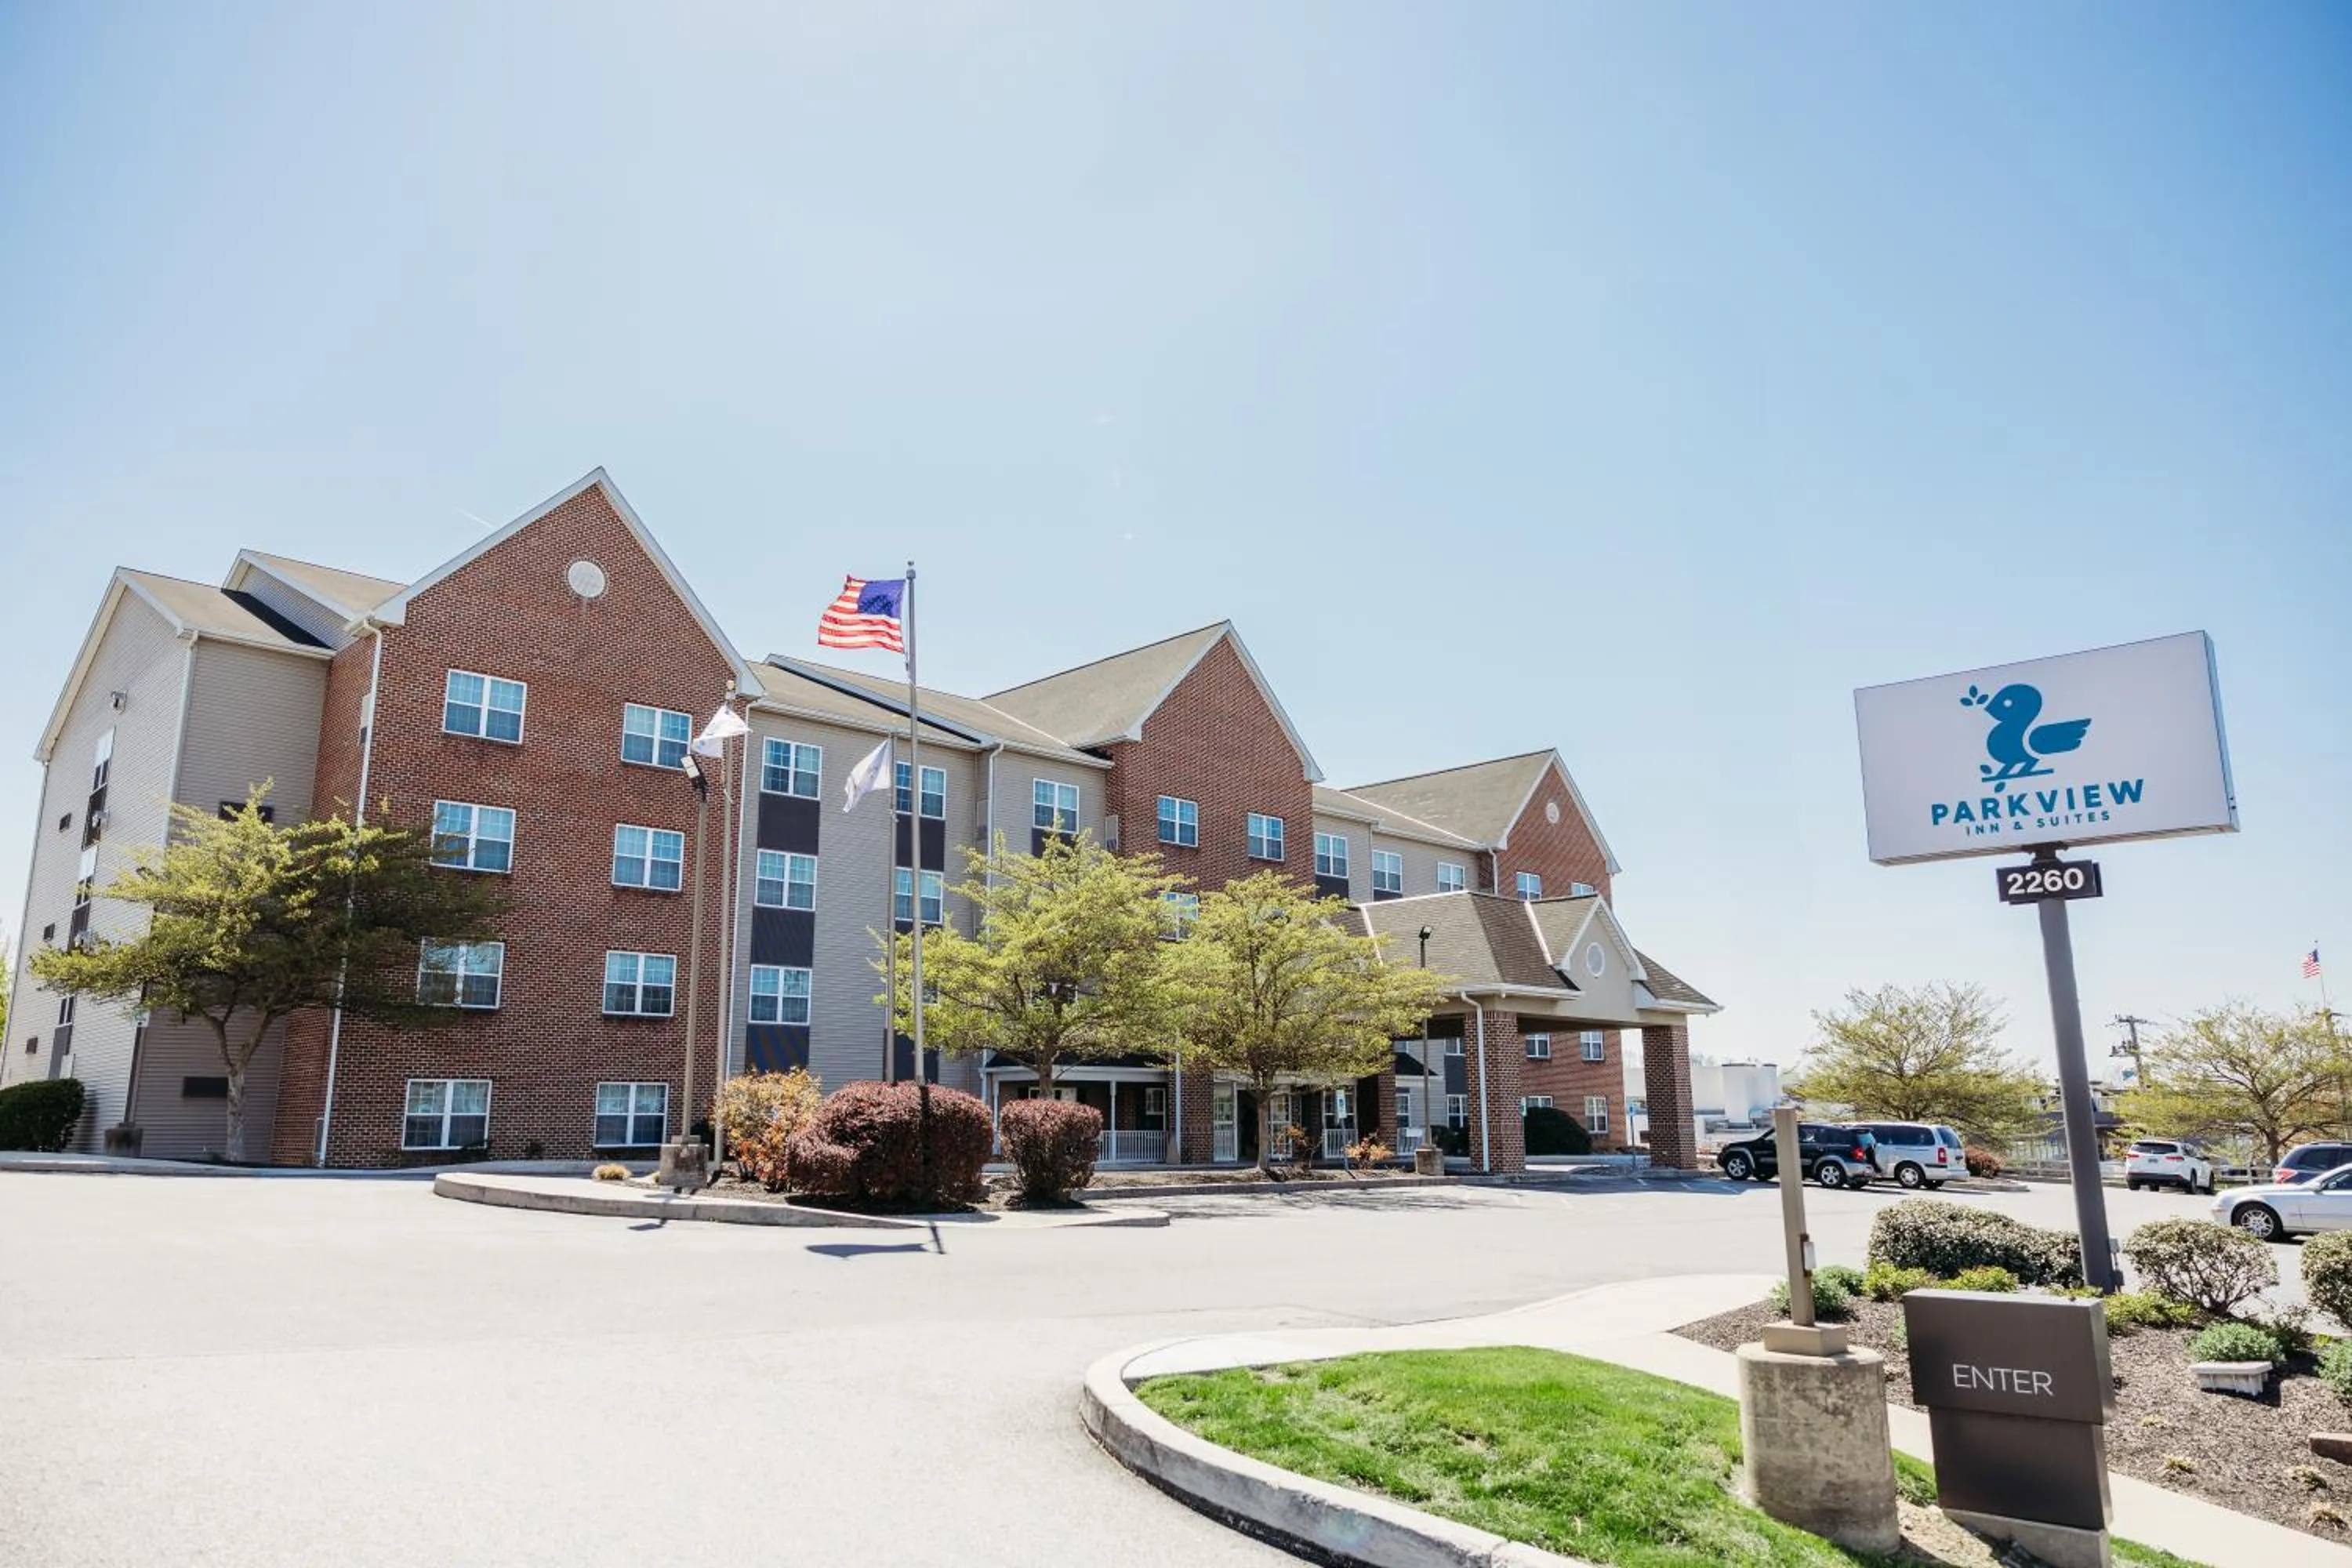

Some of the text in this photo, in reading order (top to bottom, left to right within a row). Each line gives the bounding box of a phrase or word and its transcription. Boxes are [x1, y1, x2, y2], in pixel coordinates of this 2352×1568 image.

[1931, 779, 2144, 826] PARKVIEW
[1965, 810, 2111, 837] INN & SUITES
[2006, 867, 2085, 895] 2260
[1952, 1363, 2054, 1396] ENTER
